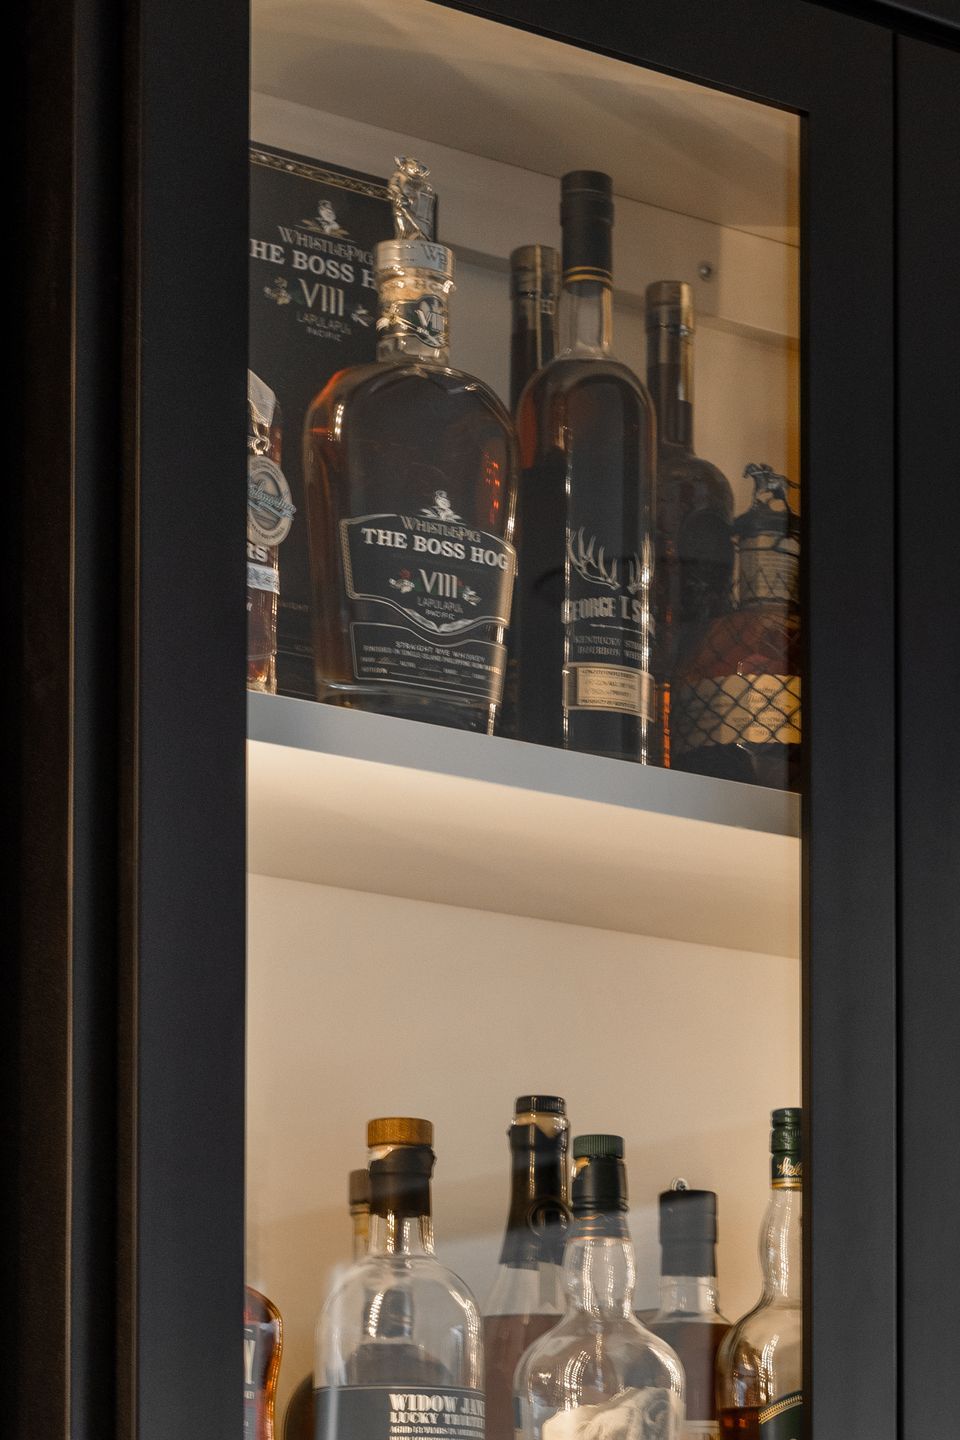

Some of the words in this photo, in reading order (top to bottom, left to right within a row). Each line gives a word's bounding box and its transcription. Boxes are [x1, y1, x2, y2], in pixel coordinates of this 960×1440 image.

[293, 249, 355, 284] BOSS
[299, 278, 345, 317] VIII
[402, 515, 482, 543] WHISTLEPIG
[360, 527, 408, 550] THE
[413, 535, 466, 560] BOSS
[471, 546, 509, 570] HOG
[418, 568, 459, 599] VIII
[561, 596, 618, 624] GEORGE
[389, 1393, 459, 1413] WIDOW
[389, 1411, 440, 1425] LUCKY
